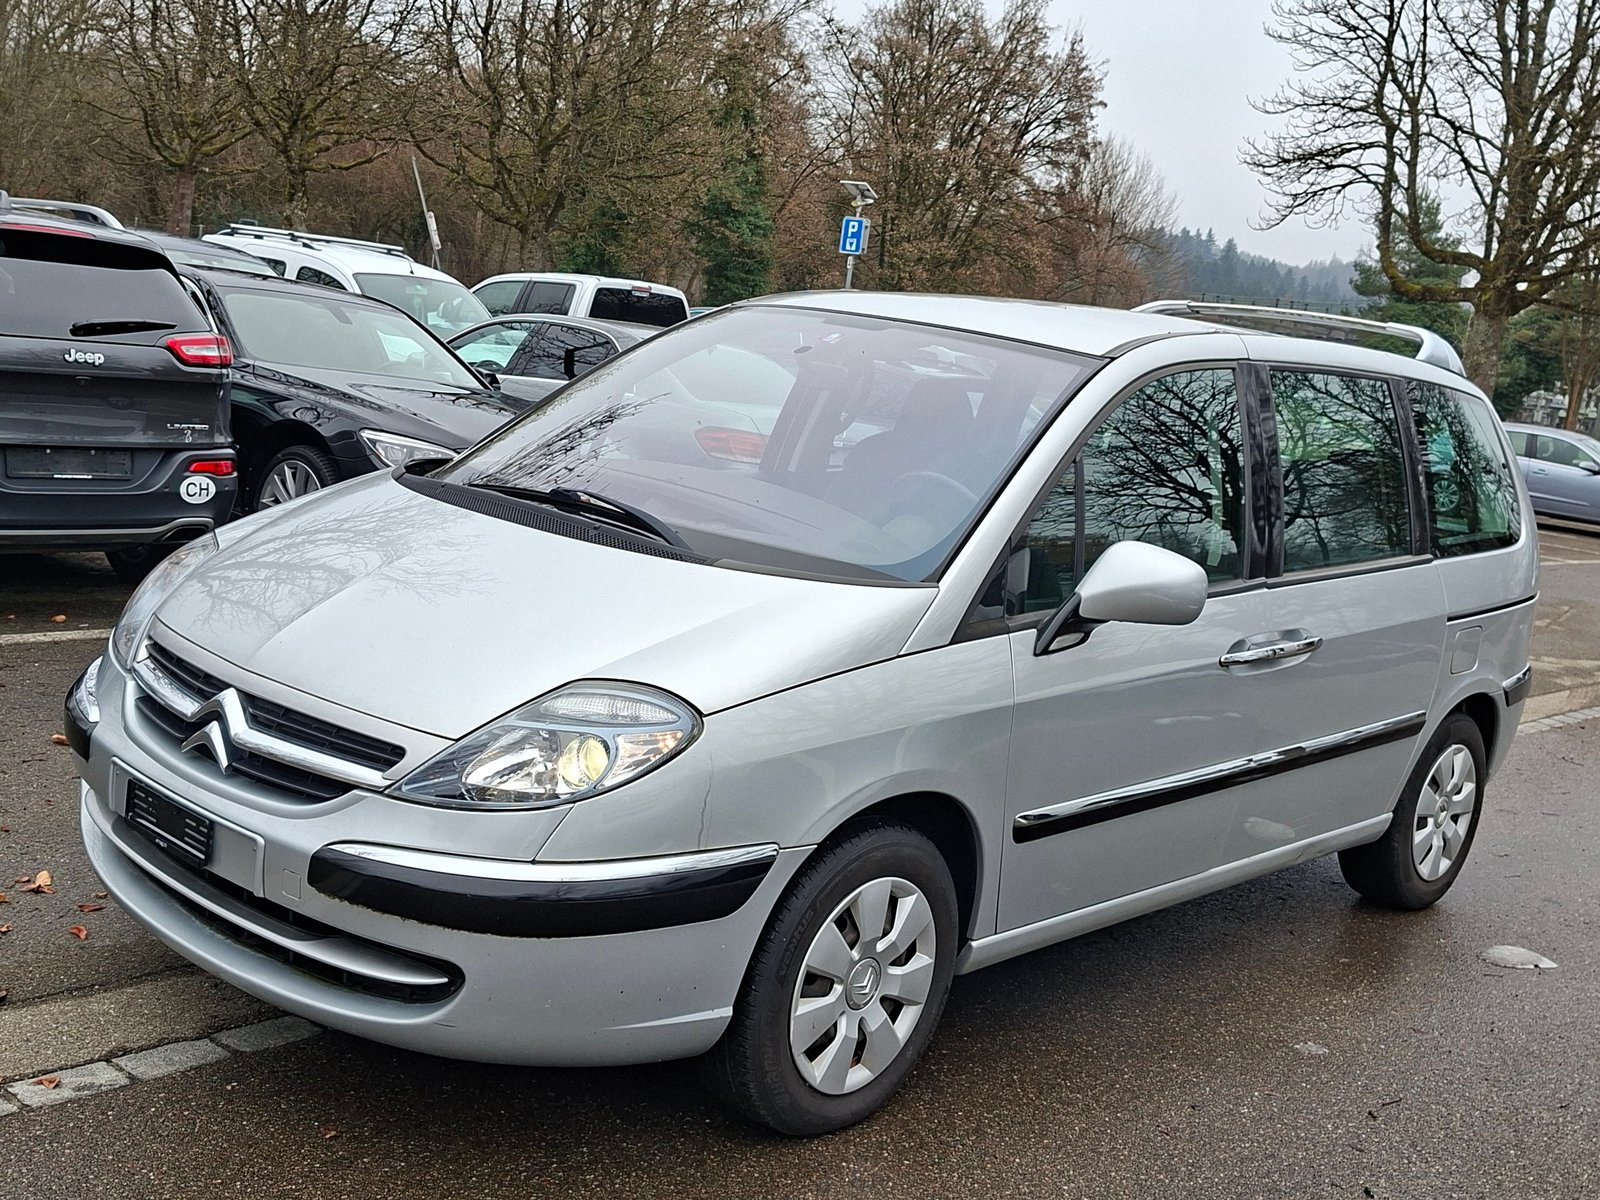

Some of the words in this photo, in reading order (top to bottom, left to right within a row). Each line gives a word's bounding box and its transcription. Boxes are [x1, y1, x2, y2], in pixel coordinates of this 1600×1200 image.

[848, 221, 859, 237] P
[64, 348, 105, 366] Jeep
[186, 482, 210, 497] CH
